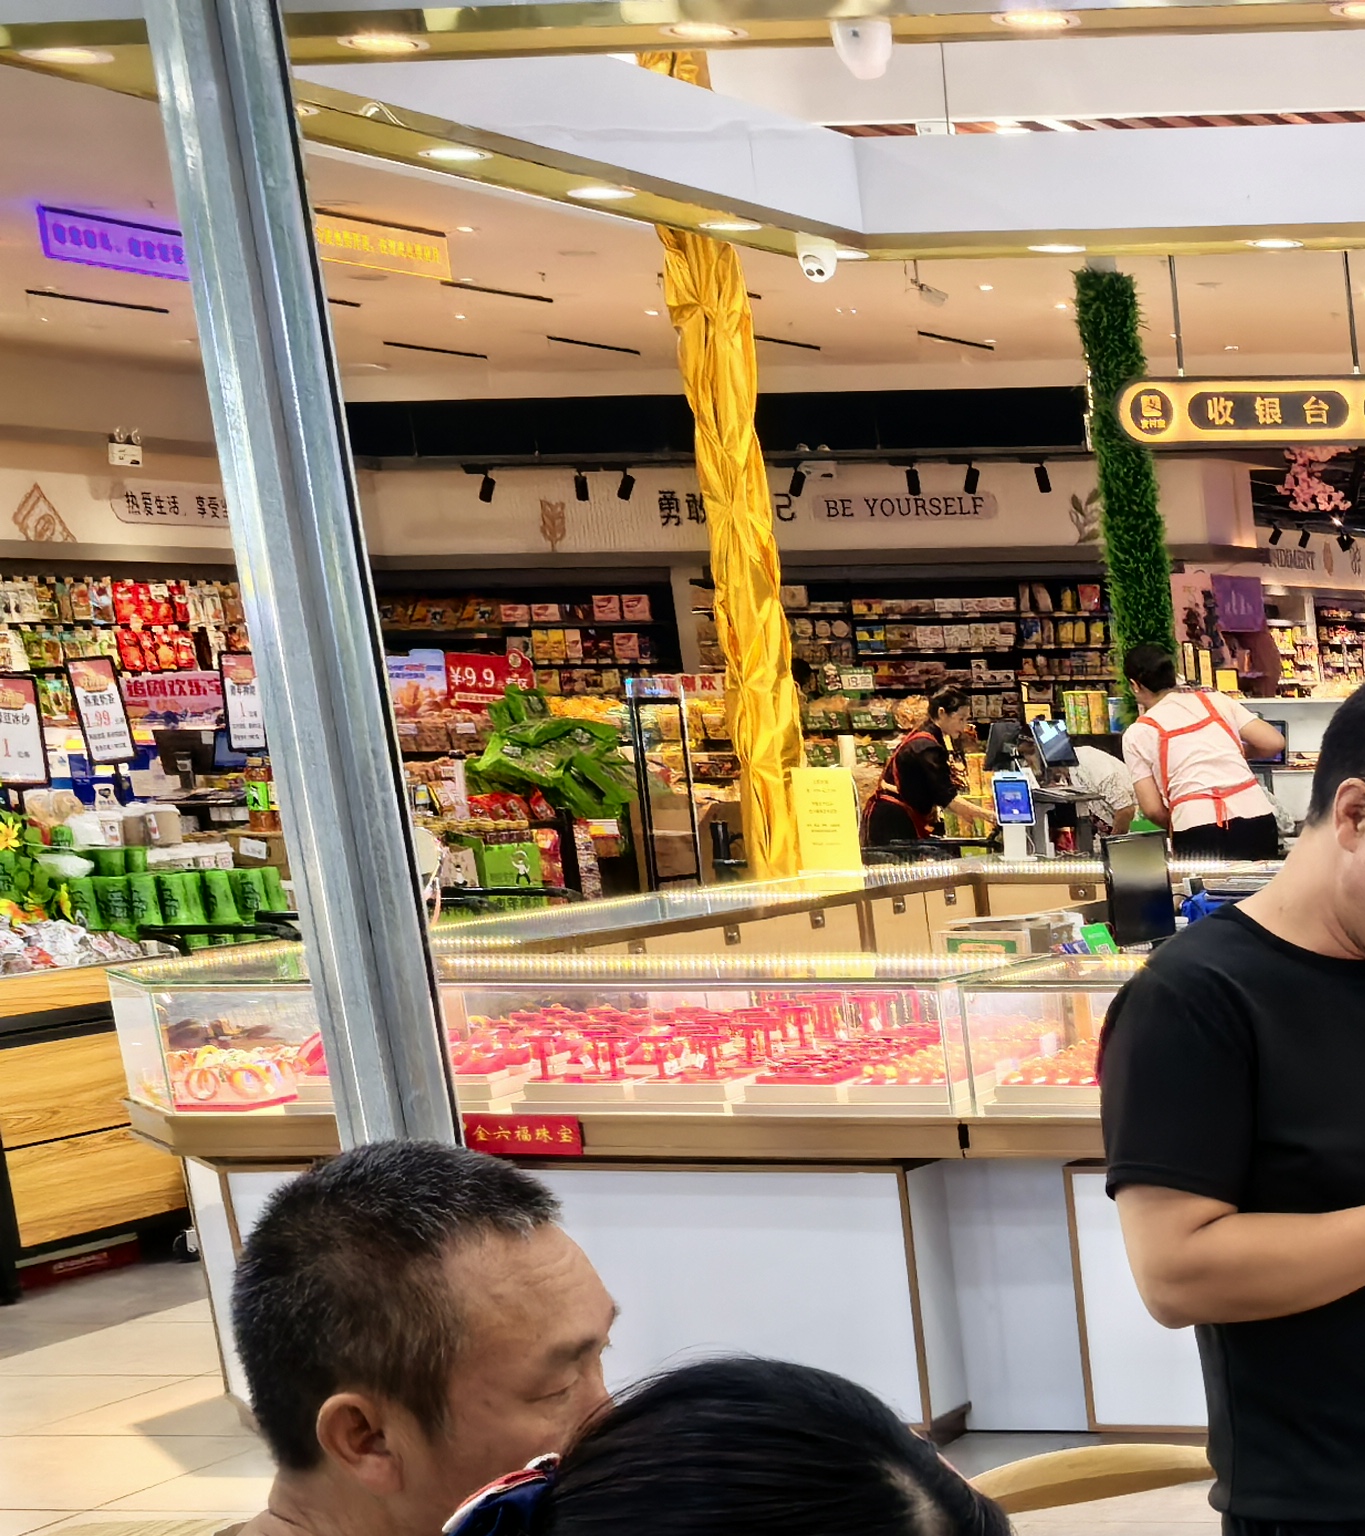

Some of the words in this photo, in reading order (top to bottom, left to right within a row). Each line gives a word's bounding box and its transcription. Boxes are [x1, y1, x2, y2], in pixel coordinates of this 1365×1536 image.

[1206, 396, 1330, 425] 收银台
[826, 500, 854, 518] BE
[866, 496, 985, 518] YOURSELF
[472, 1124, 574, 1143] 金六福珠宝
